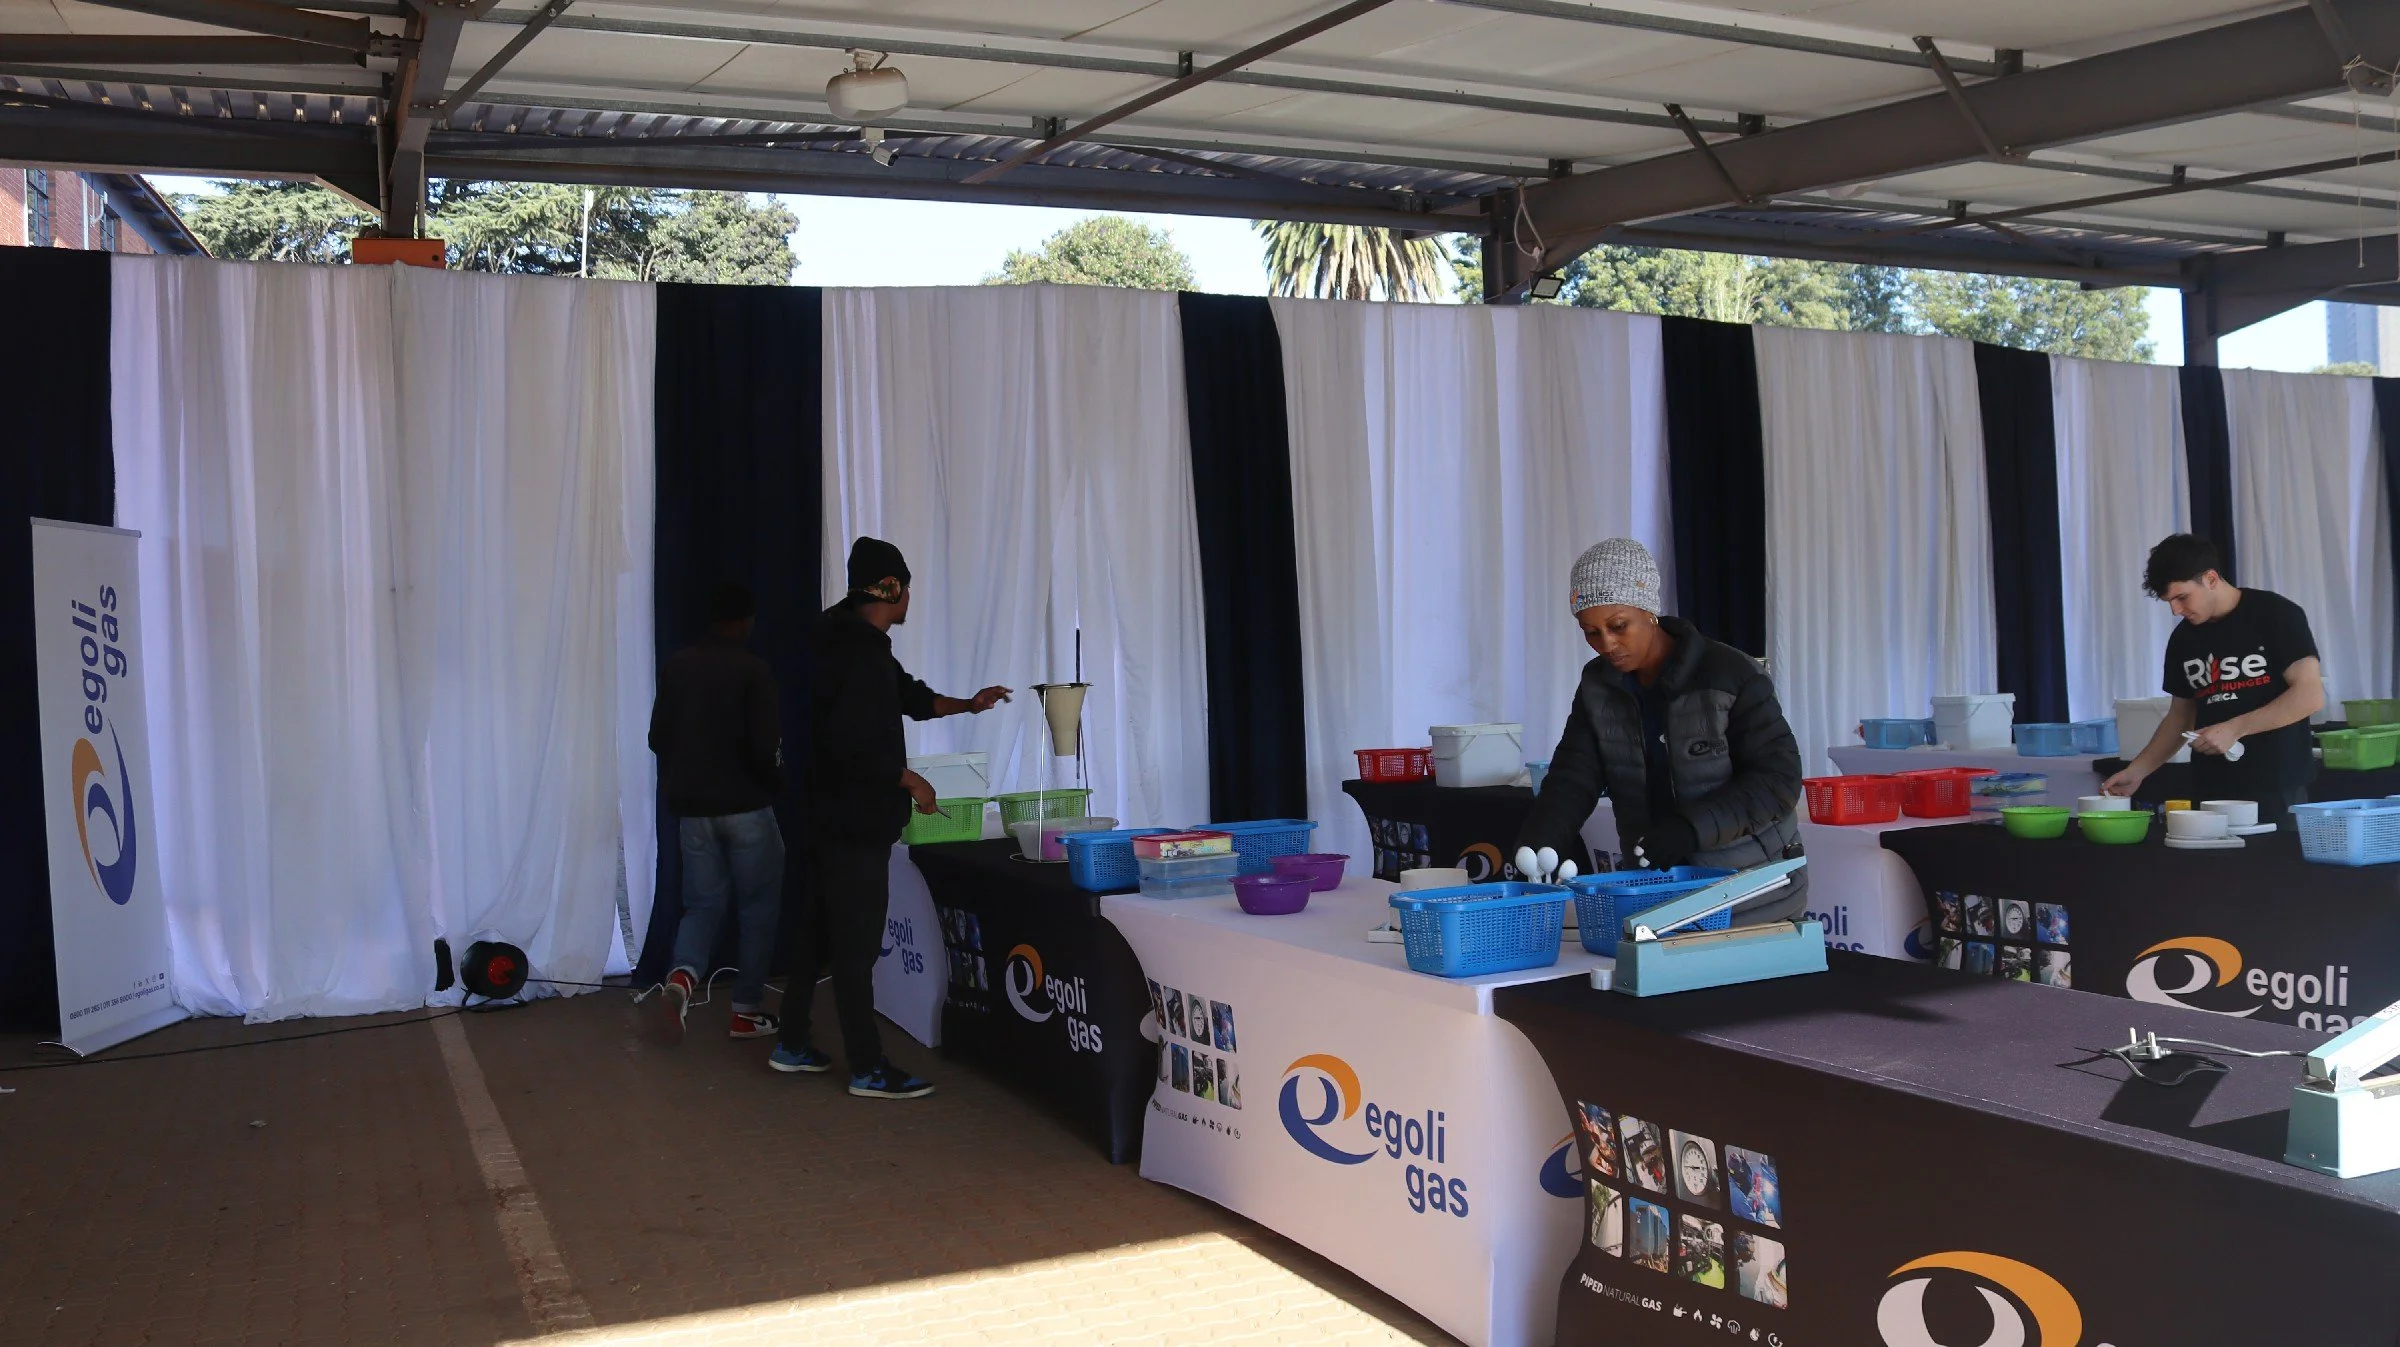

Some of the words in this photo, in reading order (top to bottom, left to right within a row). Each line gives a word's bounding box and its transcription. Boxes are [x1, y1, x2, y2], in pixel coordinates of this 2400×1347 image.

[100, 585, 127, 678] gas
[72, 600, 107, 734] egoli
[2221, 676, 2271, 692] HUNGER
[2206, 692, 2238, 705] AFRICA
[888, 917, 913, 946] egoli
[902, 948, 924, 975] gas
[1046, 973, 1087, 1015] egoli
[2246, 965, 2349, 1010] egoli
[1068, 1016, 1103, 1053] gas
[1365, 1102, 1445, 1164] egoli
[1406, 1164, 1469, 1218] gas
[1580, 1273, 1603, 1293] PIPED
[1603, 1285, 1640, 1306] NATURAL
[1641, 1297, 1662, 1312] GAS
